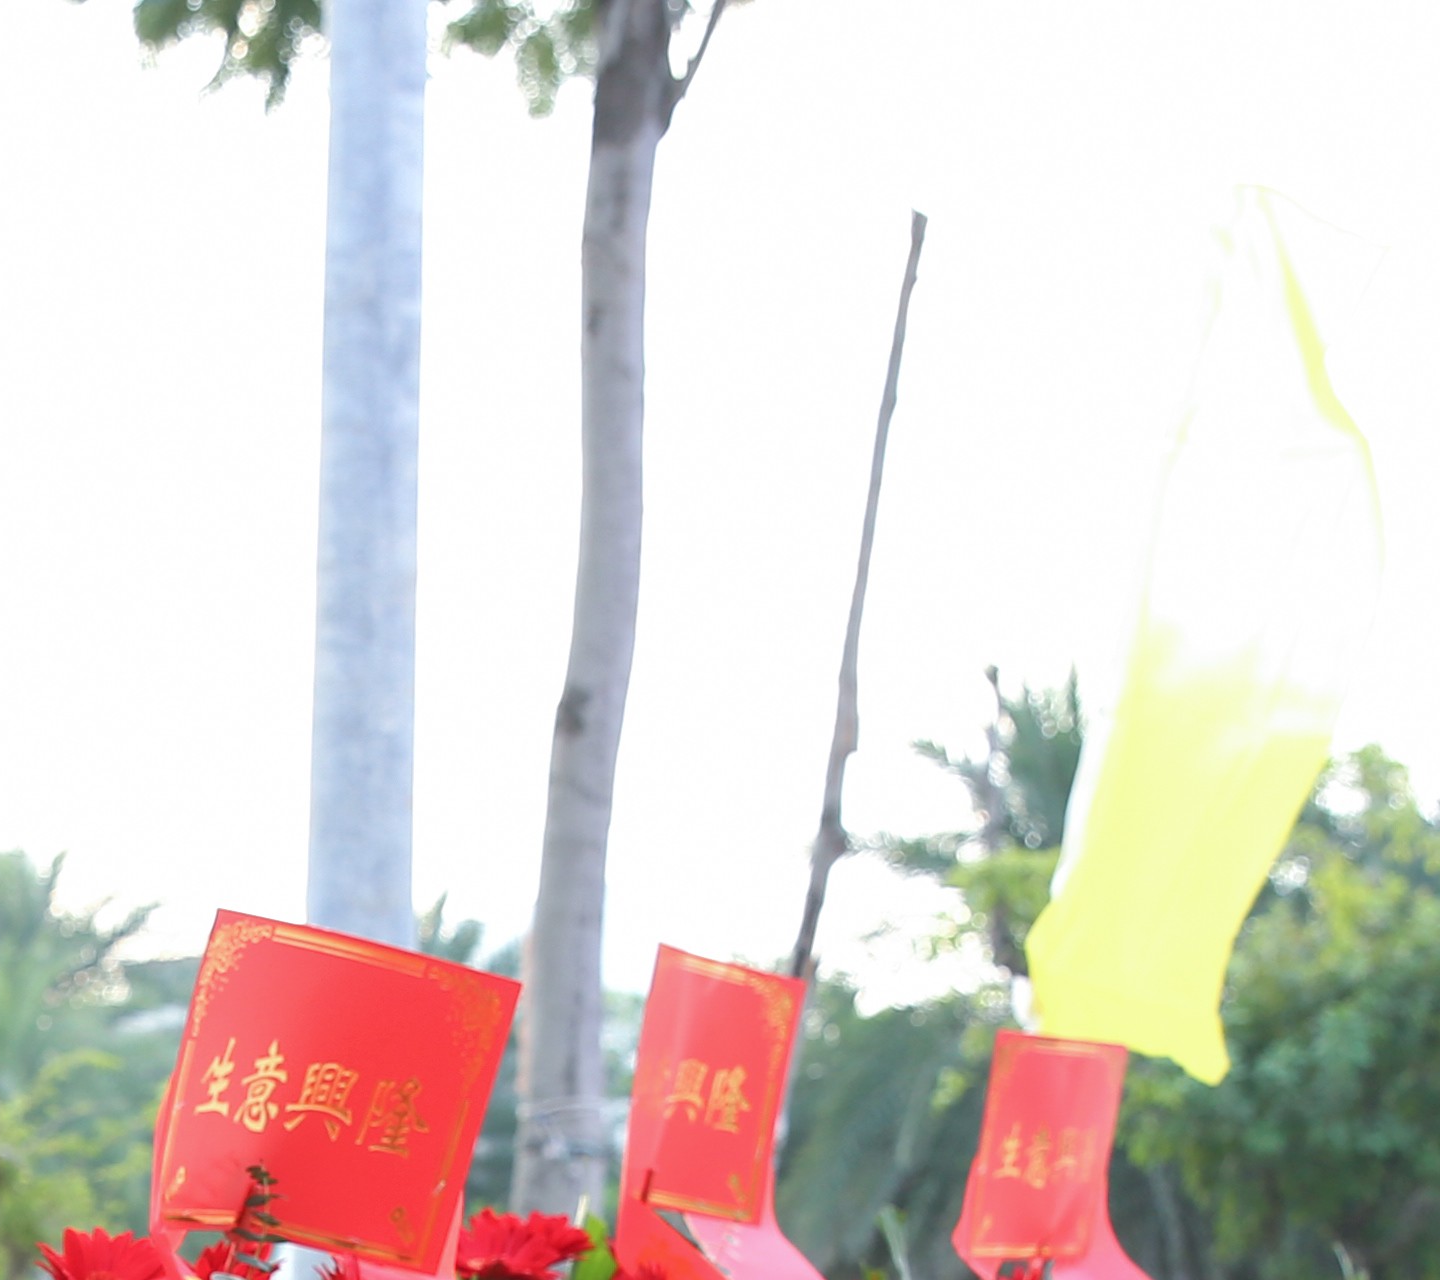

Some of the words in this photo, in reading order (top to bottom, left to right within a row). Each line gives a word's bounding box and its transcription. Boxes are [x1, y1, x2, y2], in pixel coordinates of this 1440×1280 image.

[194, 1036, 429, 1159] 生意興隆
[639, 1057, 753, 1136] 興隆
